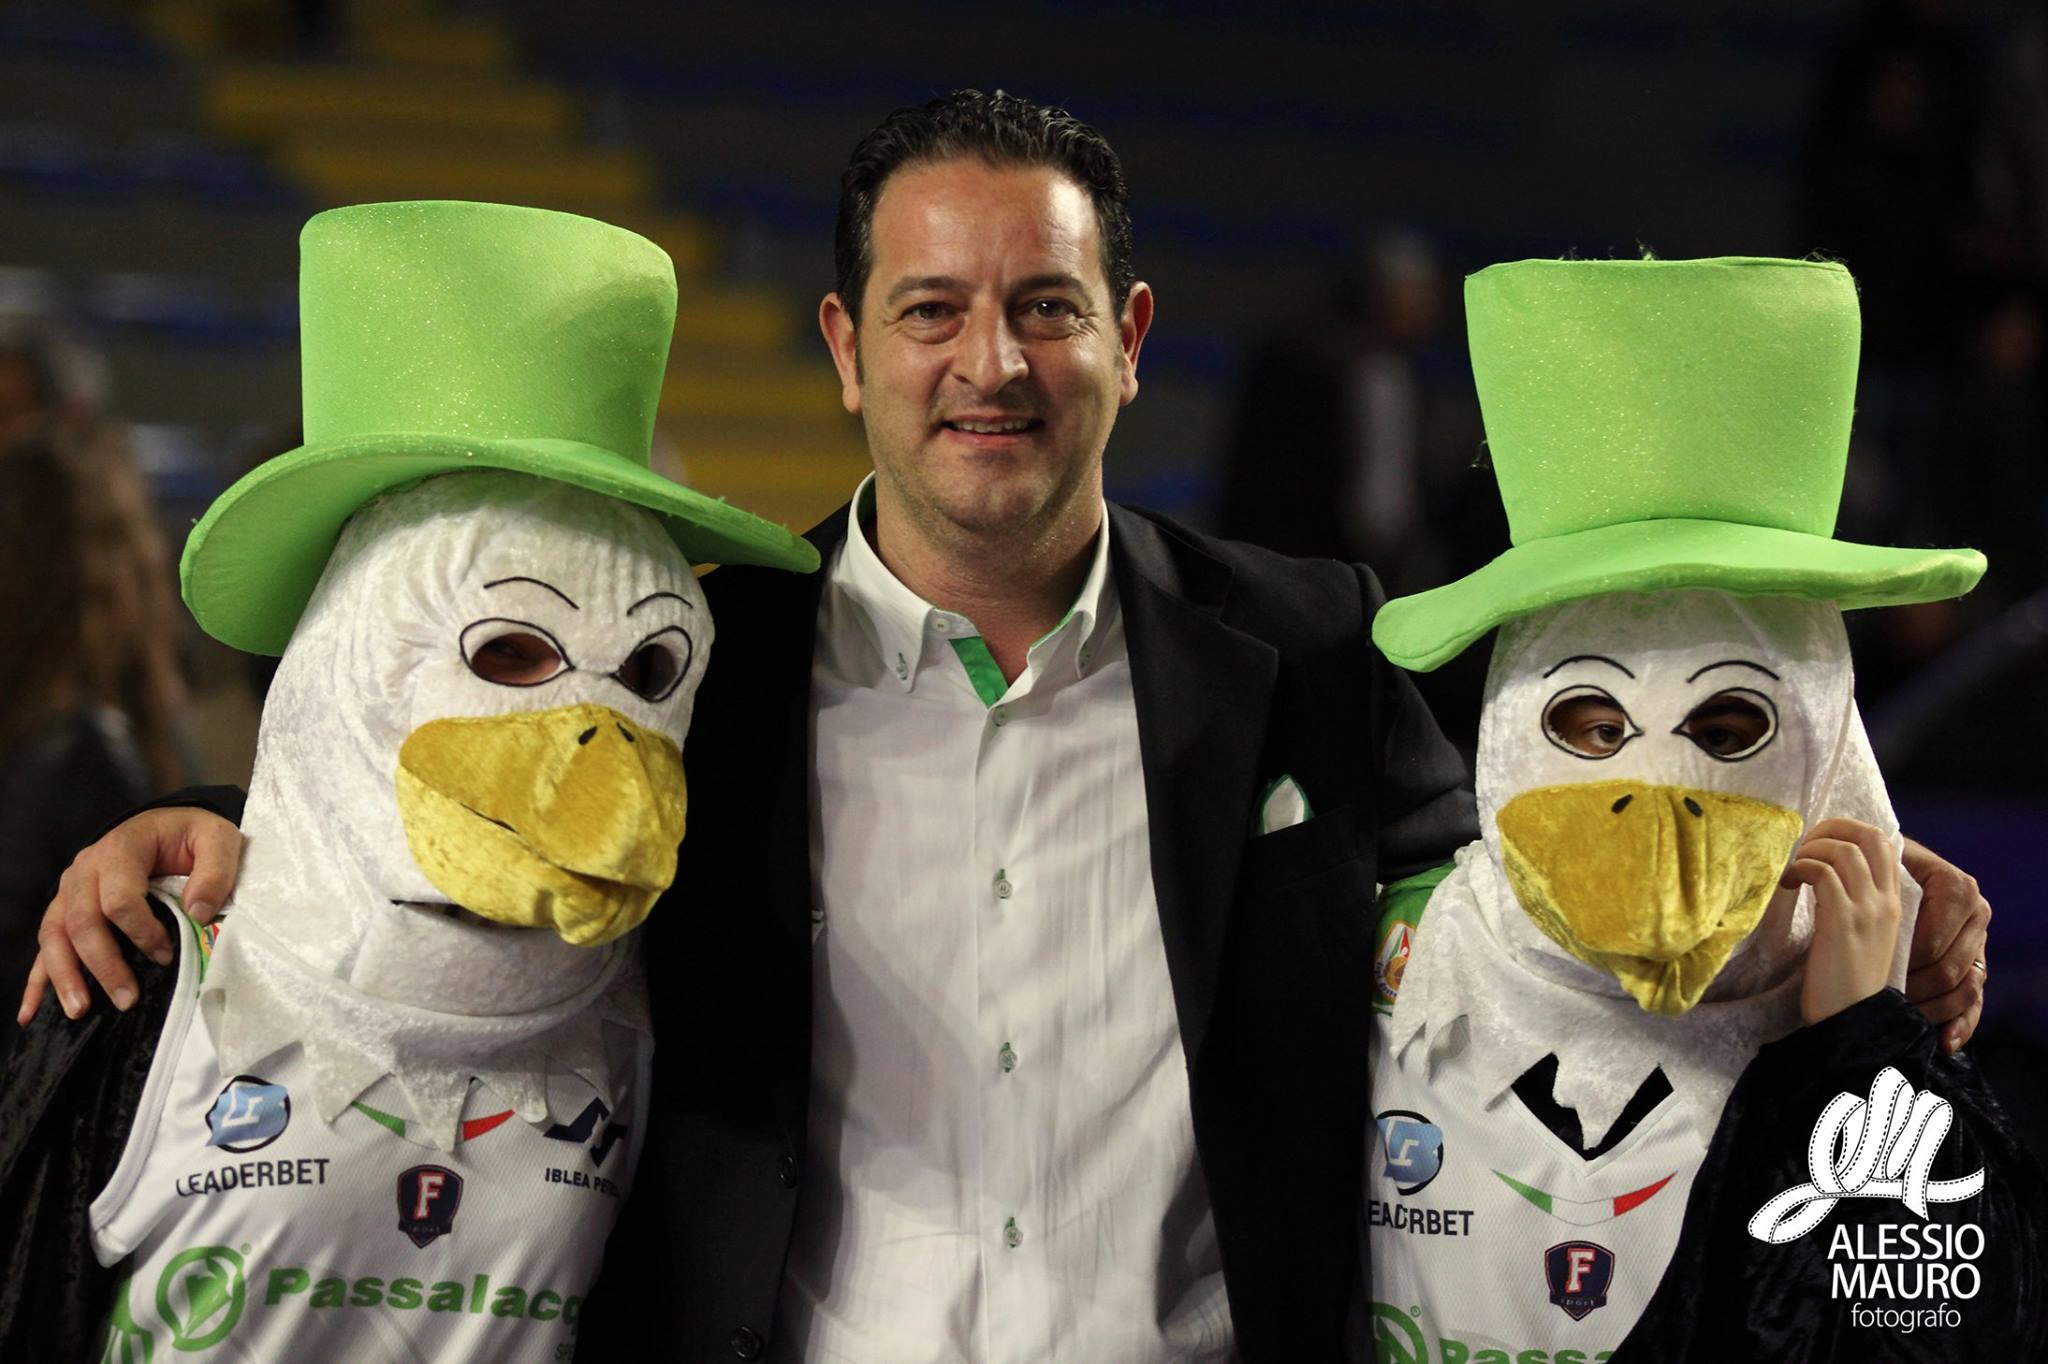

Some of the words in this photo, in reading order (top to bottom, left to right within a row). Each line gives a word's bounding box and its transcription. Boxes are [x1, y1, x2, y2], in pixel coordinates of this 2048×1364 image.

[176, 1158, 330, 1197] LEADERBET
[414, 1171, 446, 1221] F
[544, 1167, 591, 1189] IBLEA
[1364, 1200, 1475, 1236] EADRBET
[1564, 1248, 1597, 1294] F
